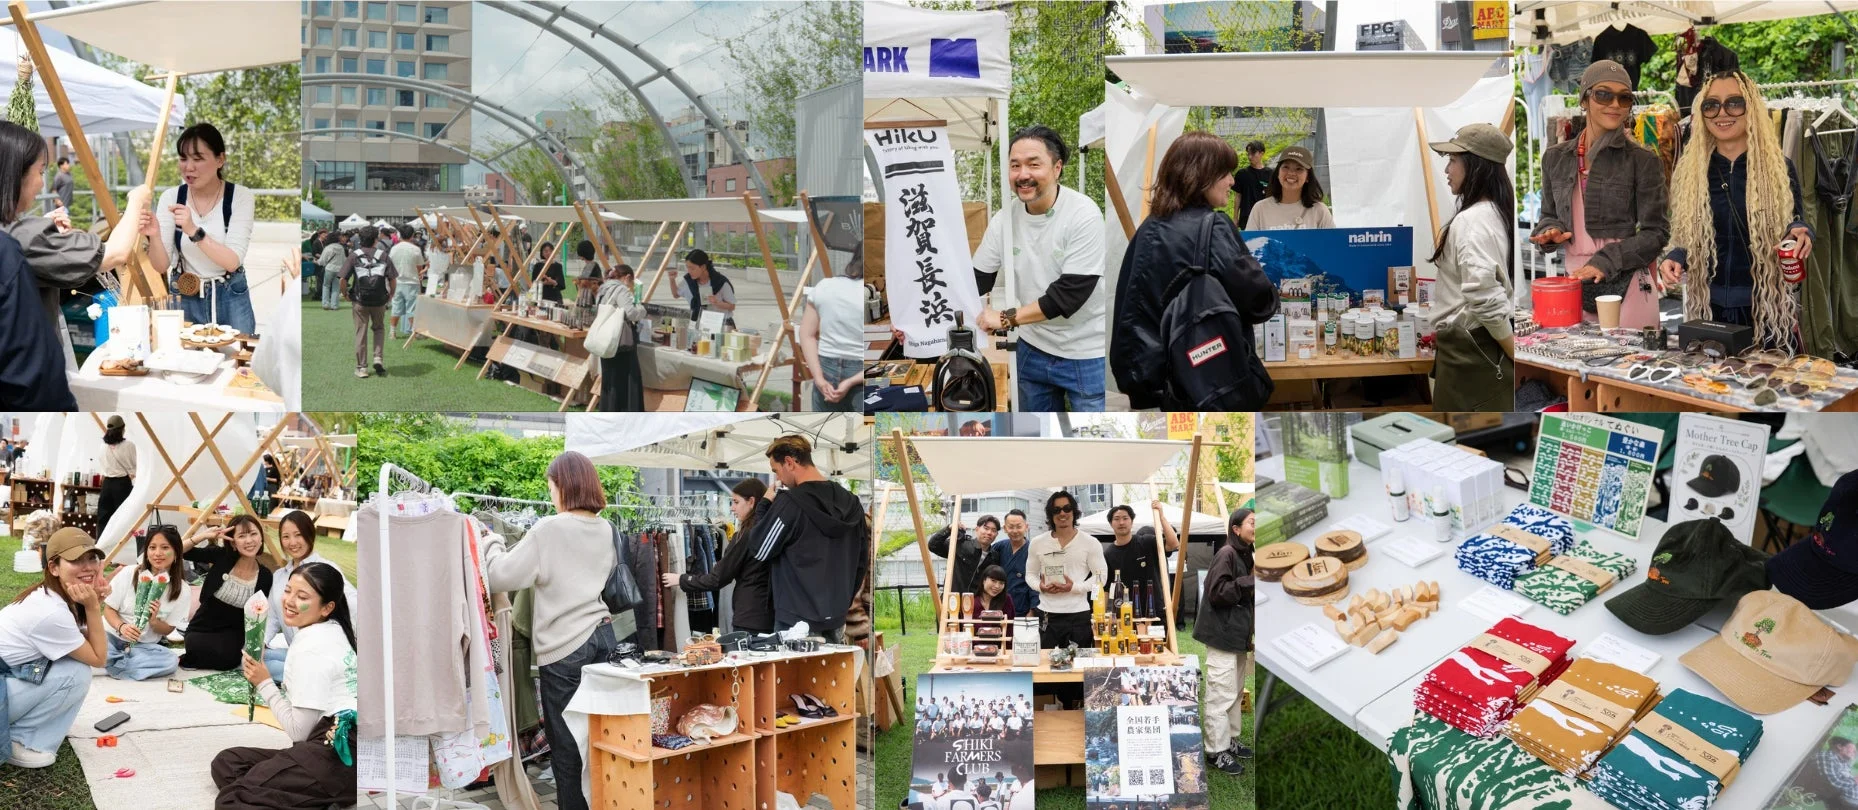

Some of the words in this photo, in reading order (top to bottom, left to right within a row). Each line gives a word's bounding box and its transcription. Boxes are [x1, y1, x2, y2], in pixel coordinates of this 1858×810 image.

[1360, 21, 1395, 37] FPG
[1348, 230, 1393, 244] nahrin
[898, 183, 955, 329] 滋賀長浜
[1191, 342, 1223, 361] HUNTER
[1170, 412, 1194, 425] ABC
[1170, 423, 1194, 433] MART
[1686, 428, 1718, 443] Mother
[1719, 434, 1740, 447] Tree
[1741, 440, 1758, 453] Cap
[952, 738, 994, 752] SHIKI
[944, 750, 1002, 763] FARMERS
[955, 762, 990, 776] CLUB
